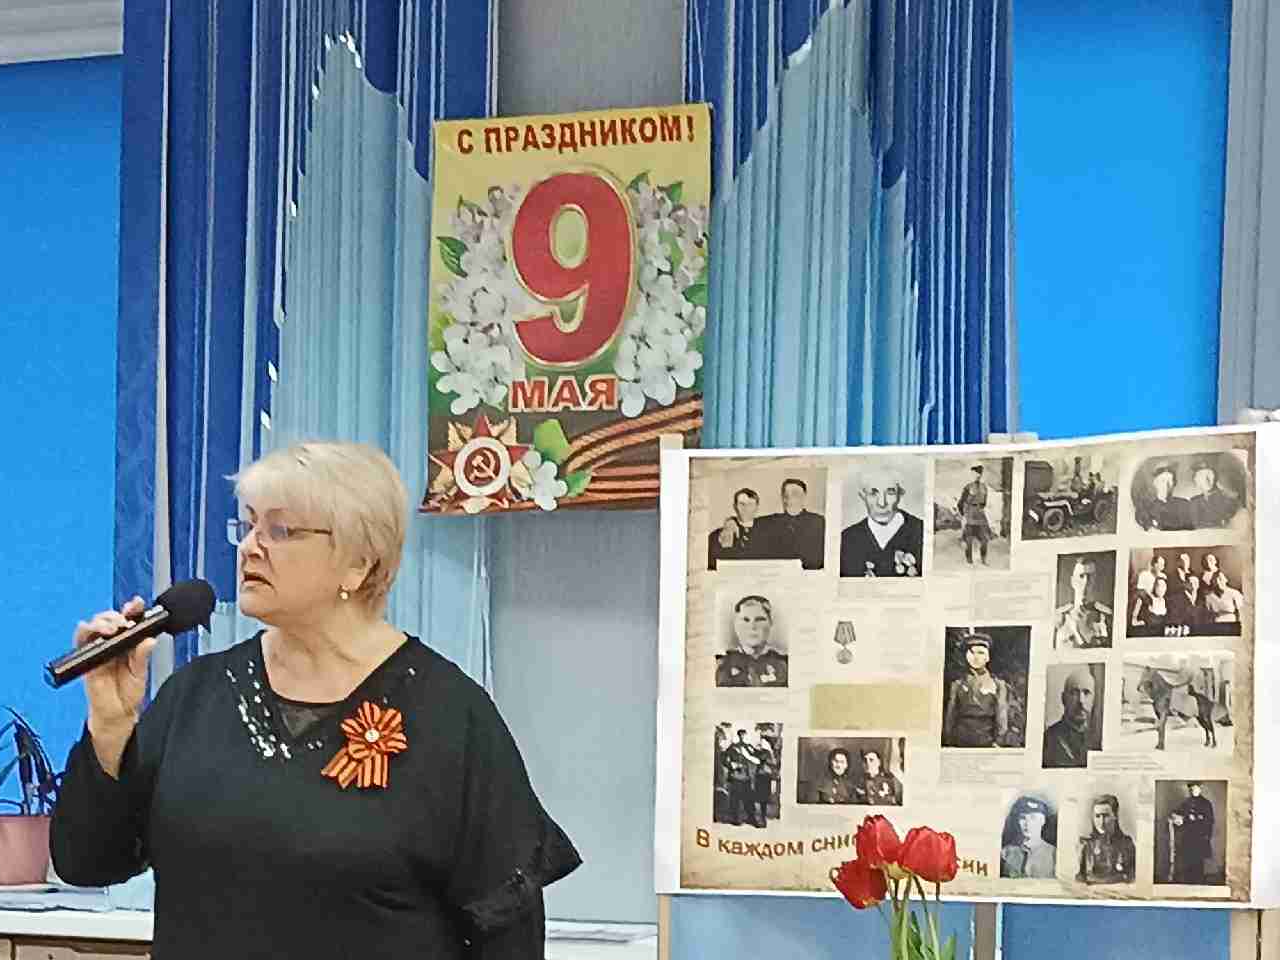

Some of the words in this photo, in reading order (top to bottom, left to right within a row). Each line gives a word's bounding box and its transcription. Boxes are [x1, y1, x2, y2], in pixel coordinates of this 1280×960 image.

[457, 129, 474, 154] С
[484, 114, 695, 154] ПРАЗДНИКОМ!
[511, 171, 634, 364] 9
[510, 376, 617, 410] МАЯ
[696, 828, 711, 849] В
